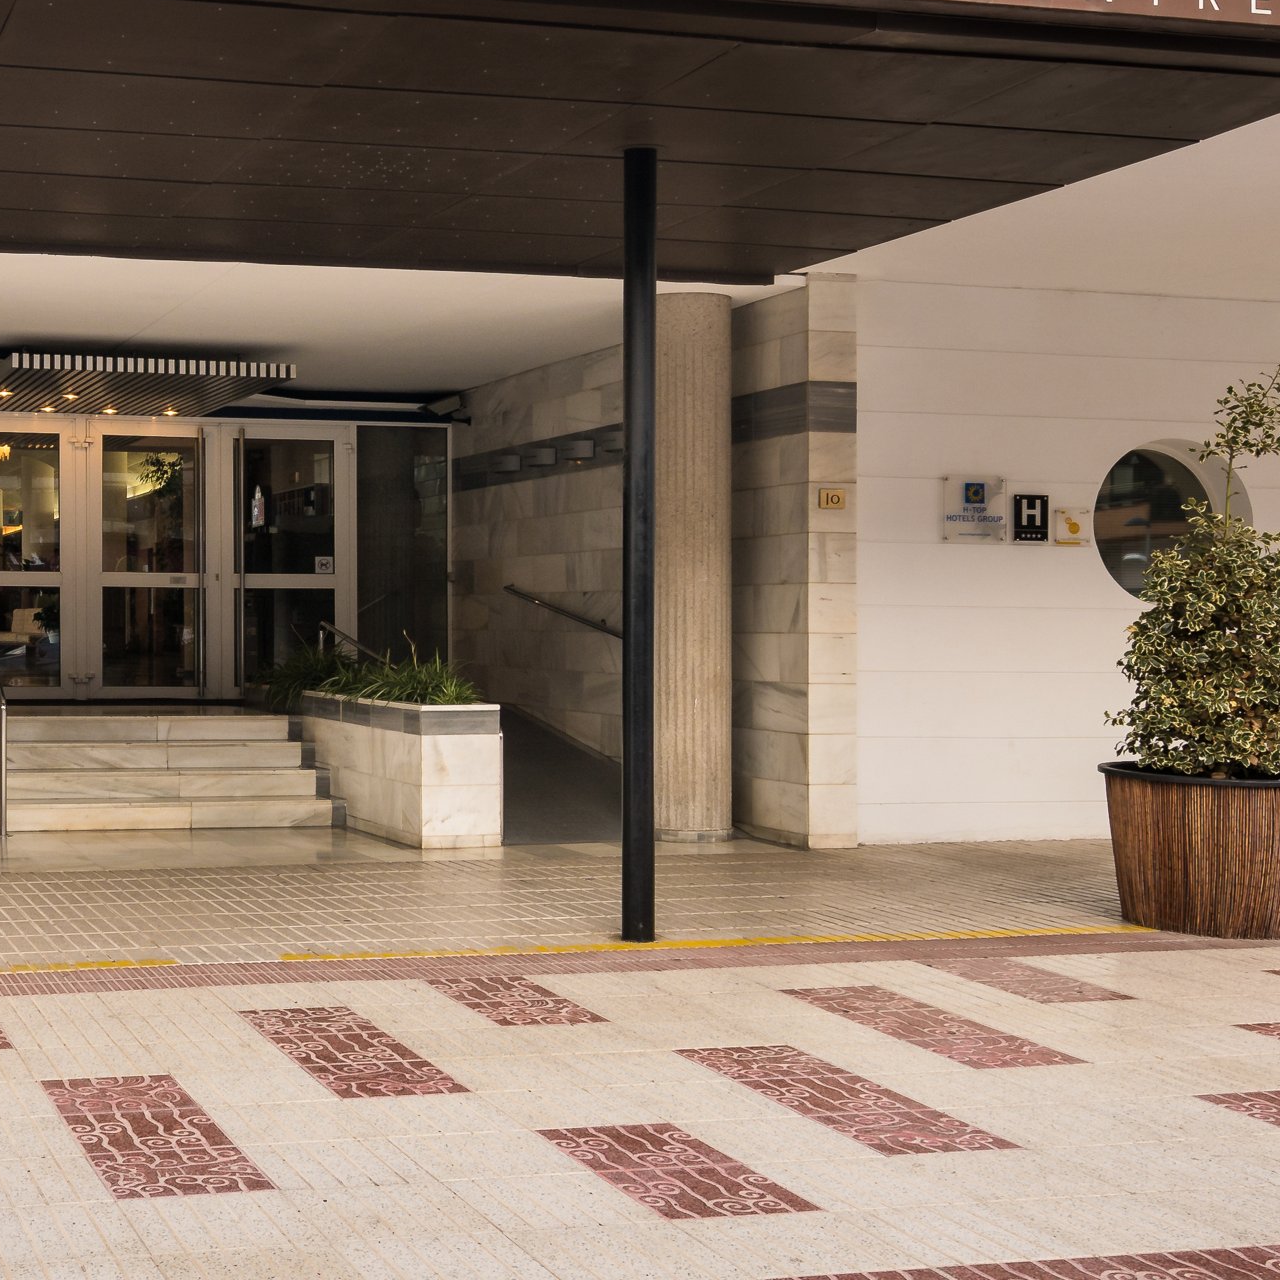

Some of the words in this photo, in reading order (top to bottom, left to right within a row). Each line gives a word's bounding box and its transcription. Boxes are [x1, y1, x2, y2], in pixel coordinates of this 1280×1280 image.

[946, 514, 976, 523] HOTELS
[977, 515, 1004, 524] GROUP
[1021, 499, 1041, 526] H
